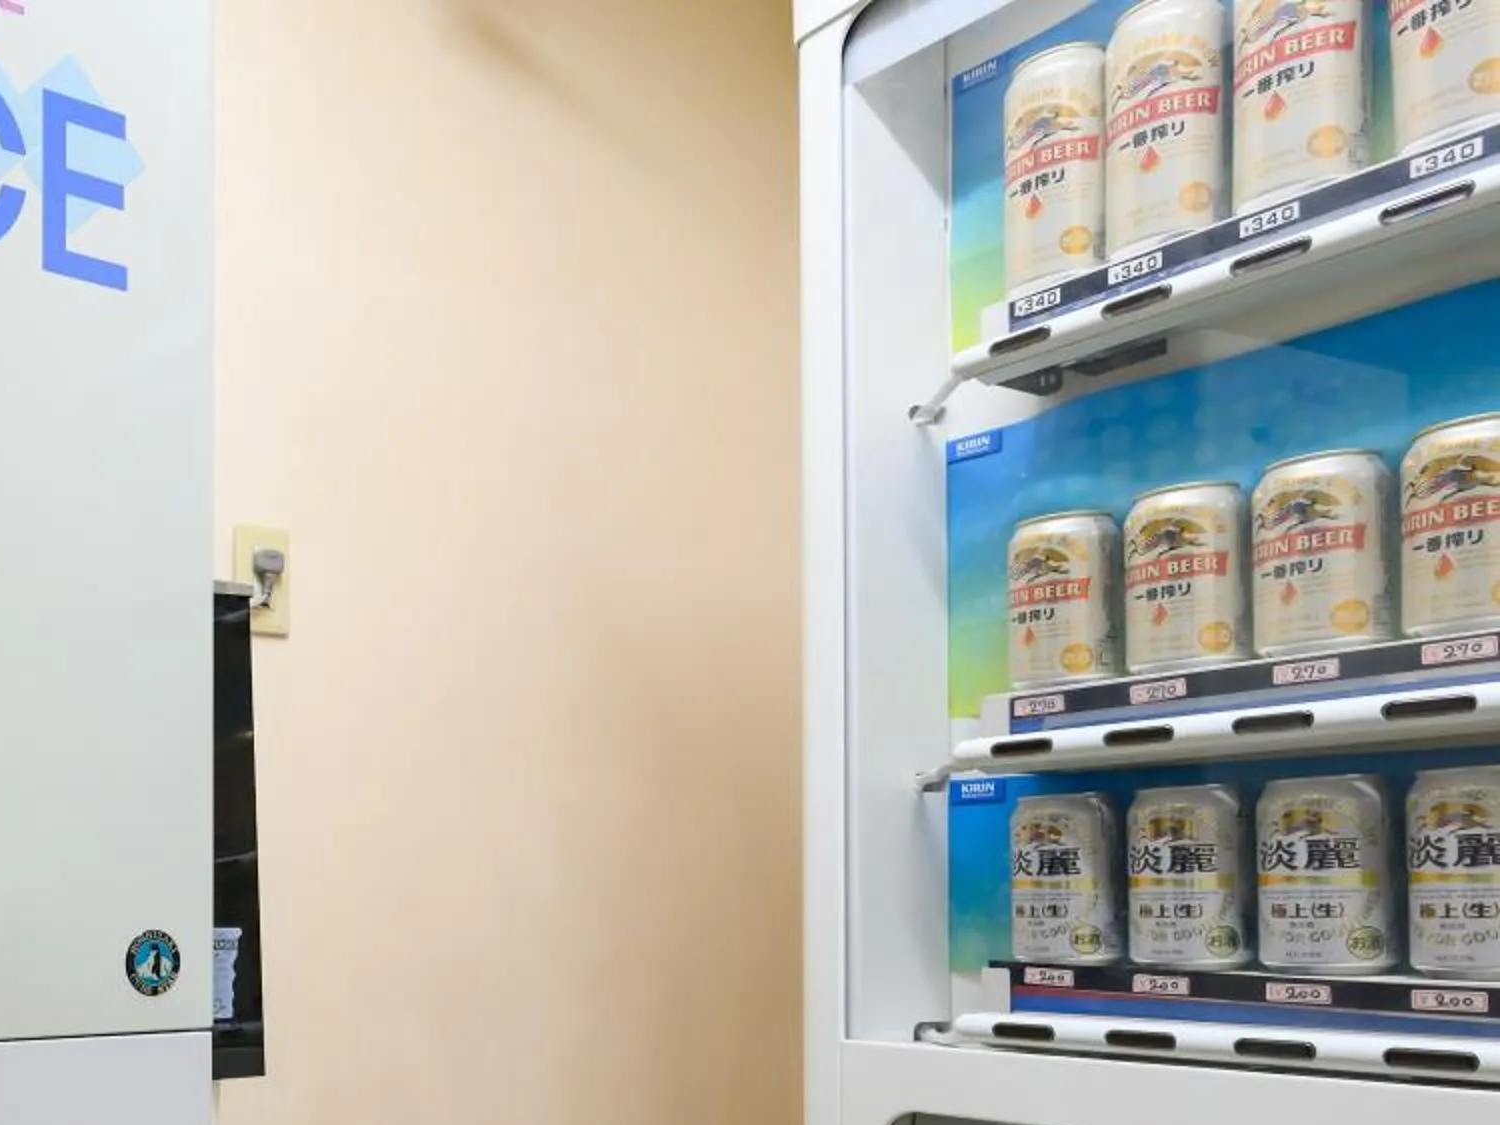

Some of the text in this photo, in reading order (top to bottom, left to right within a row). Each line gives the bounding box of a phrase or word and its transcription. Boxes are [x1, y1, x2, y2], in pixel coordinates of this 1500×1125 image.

[1285, 29, 1345, 55] BEER
[963, 59, 997, 83] KIRIN
[1242, 61, 1314, 98] 一番搾り
[1158, 93, 1210, 113] BEER
[1119, 120, 1184, 150] 一番搾り
[1041, 142, 1090, 163] BEER
[956, 436, 990, 452] KIRIN
[1453, 499, 1500, 519] BEE
[1297, 530, 1354, 550] BEER
[1412, 529, 1484, 552] 一番搾り
[1167, 557, 1218, 575] BEER
[1261, 558, 1323, 579] 一番搾り
[1034, 583, 1080, 599] BEER
[1134, 582, 1191, 601] 一番搾り
[961, 782, 995, 794] KIRIN
[1013, 847, 1082, 876] 淡麗
[1130, 843, 1220, 874] 淡麗
[1261, 837, 1361, 871] 淡麗
[1410, 833, 1500, 869] 淡麗
